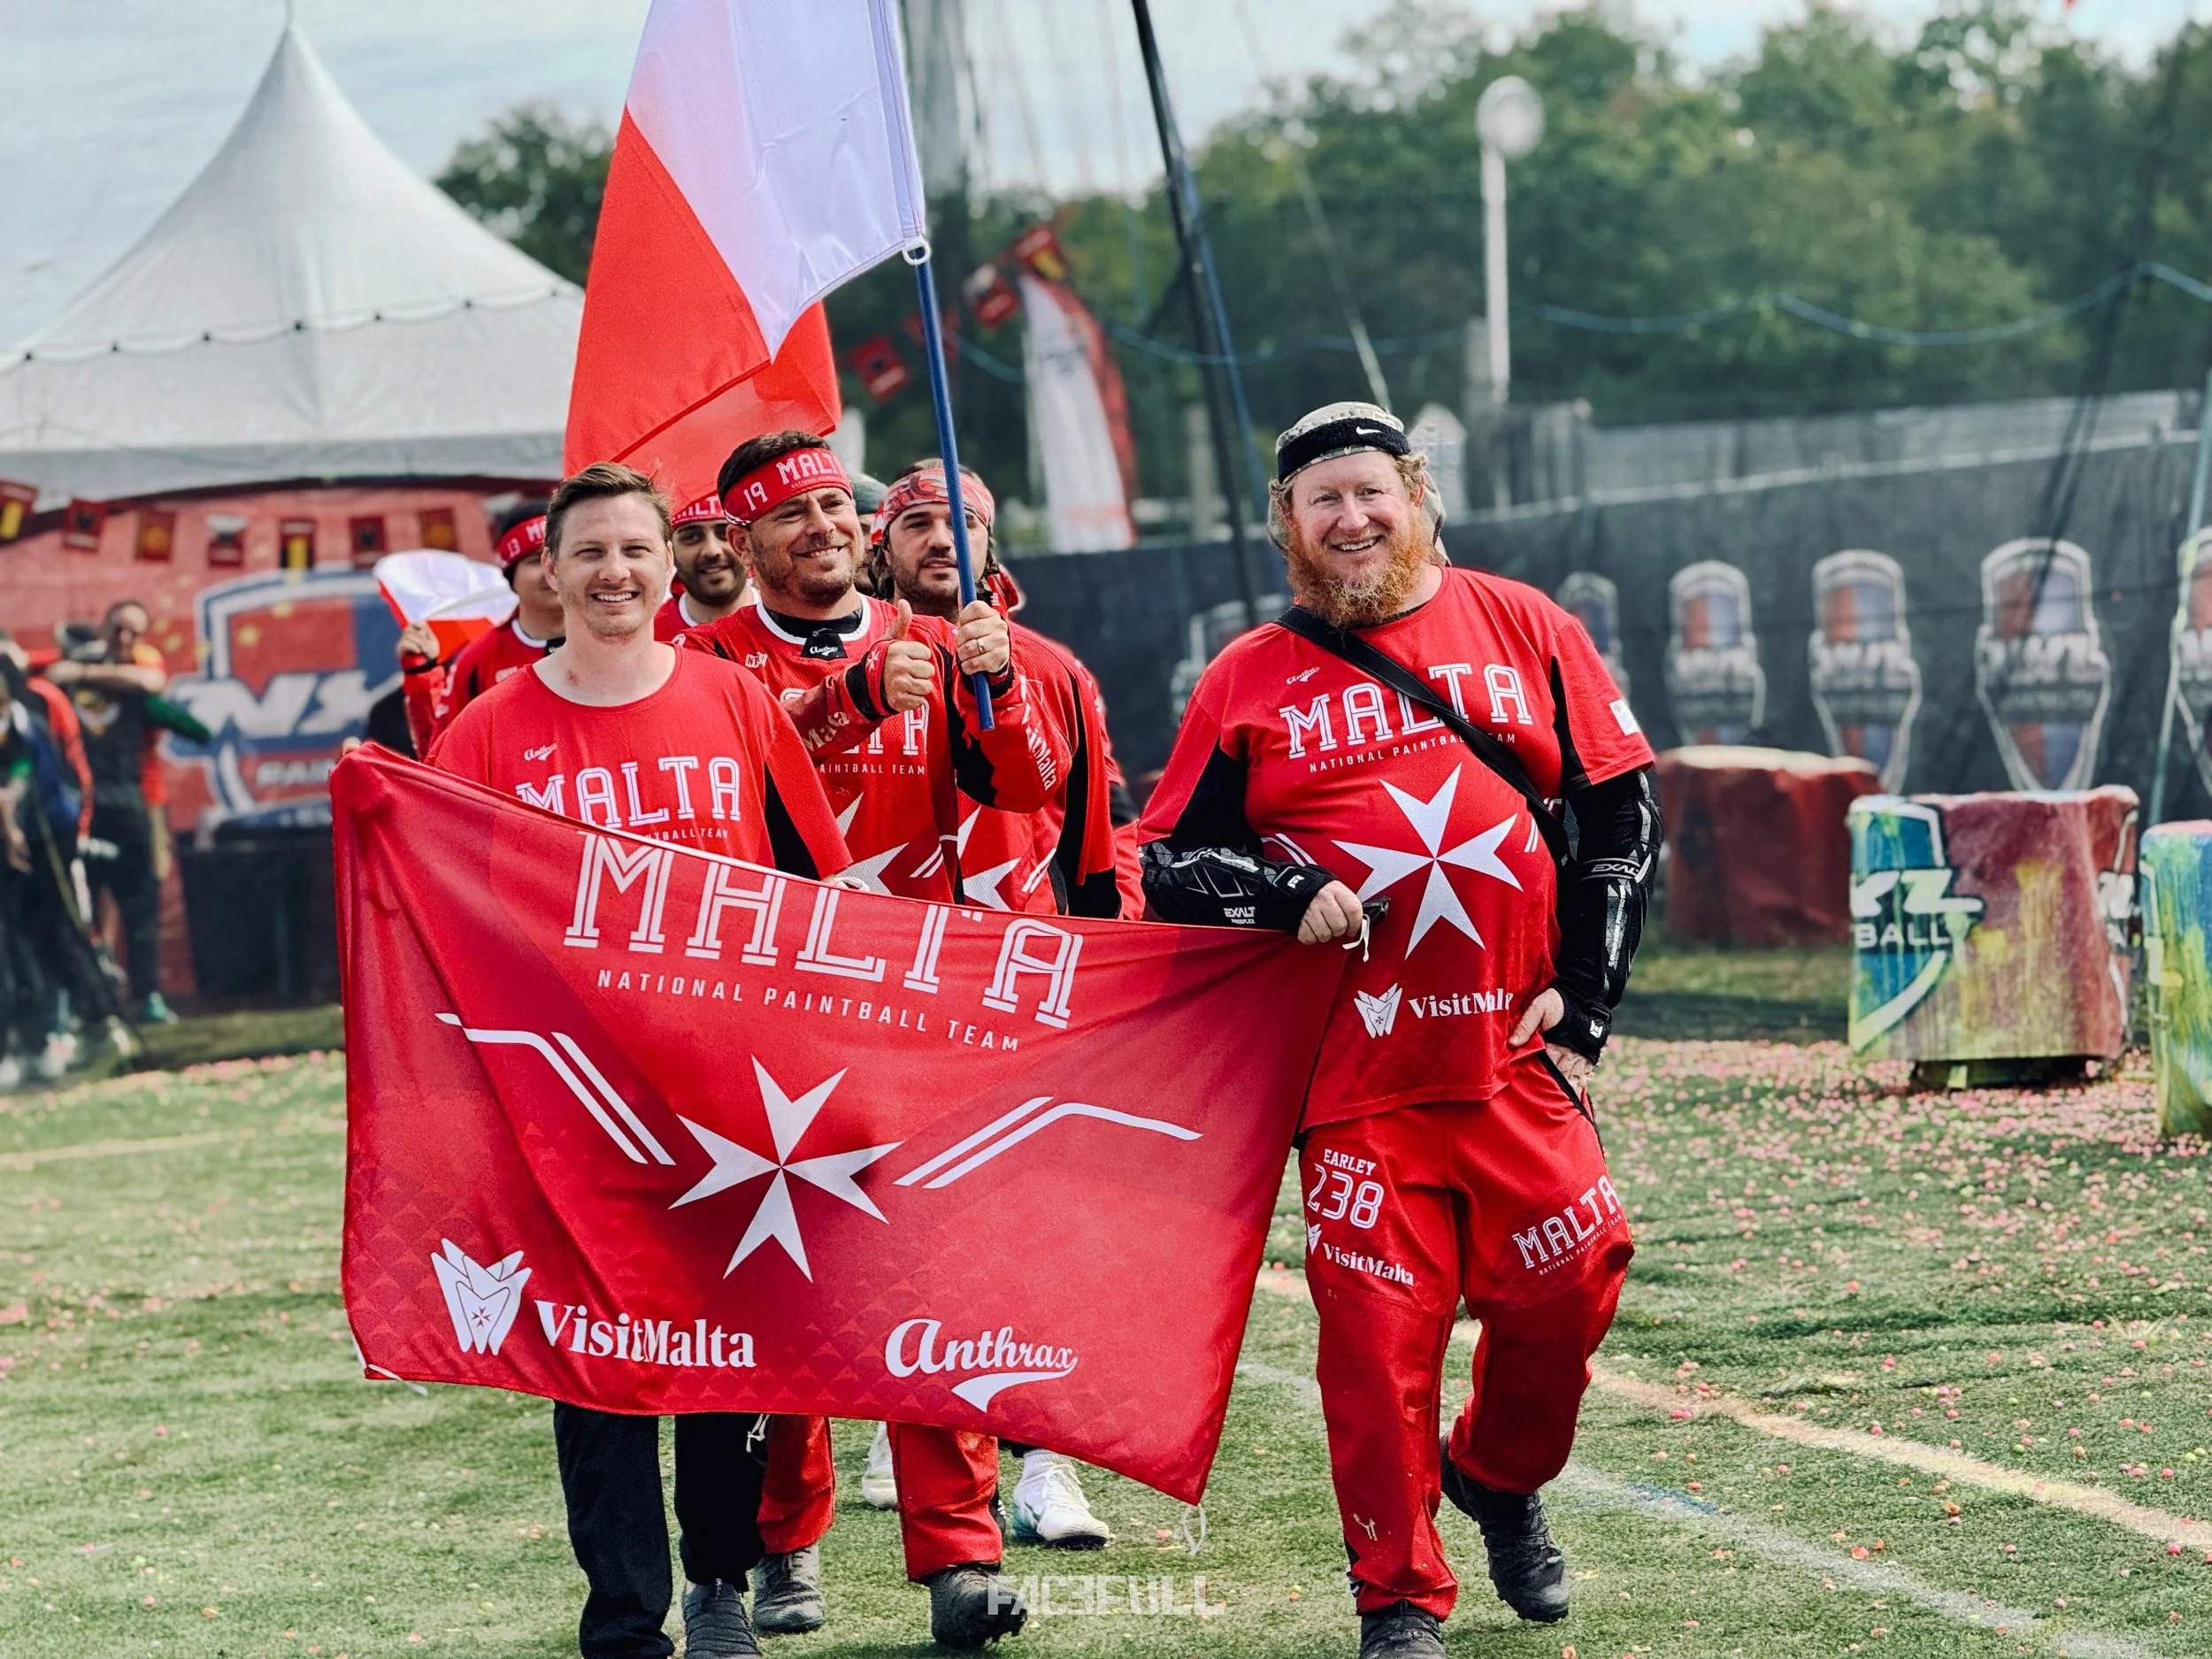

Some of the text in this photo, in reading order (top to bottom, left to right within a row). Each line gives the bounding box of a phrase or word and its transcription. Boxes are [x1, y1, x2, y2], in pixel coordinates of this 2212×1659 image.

[776, 452, 846, 485] MALT
[743, 481, 768, 511] 19
[819, 763, 926, 775] AINTBALL TEAM
[1310, 749, 1386, 773] NATIONAL
[1393, 733, 1465, 757] PAINTBAL
[699, 828, 728, 839] TEAM
[1223, 906, 1256, 918] EXALT
[597, 969, 1018, 1052] NATIONAL PAINTBALL TEAM
[1323, 1148, 1377, 1177] EARLEY
[1307, 1163, 1385, 1230] 238
[1511, 1174, 1621, 1270] MALTA
[1322, 1241, 1415, 1286] VisitMalta
[1538, 1254, 1575, 1276] NATIONAL
[534, 1299, 757, 1368] VisitMalta
[885, 1318, 1078, 1379] Anthrax
